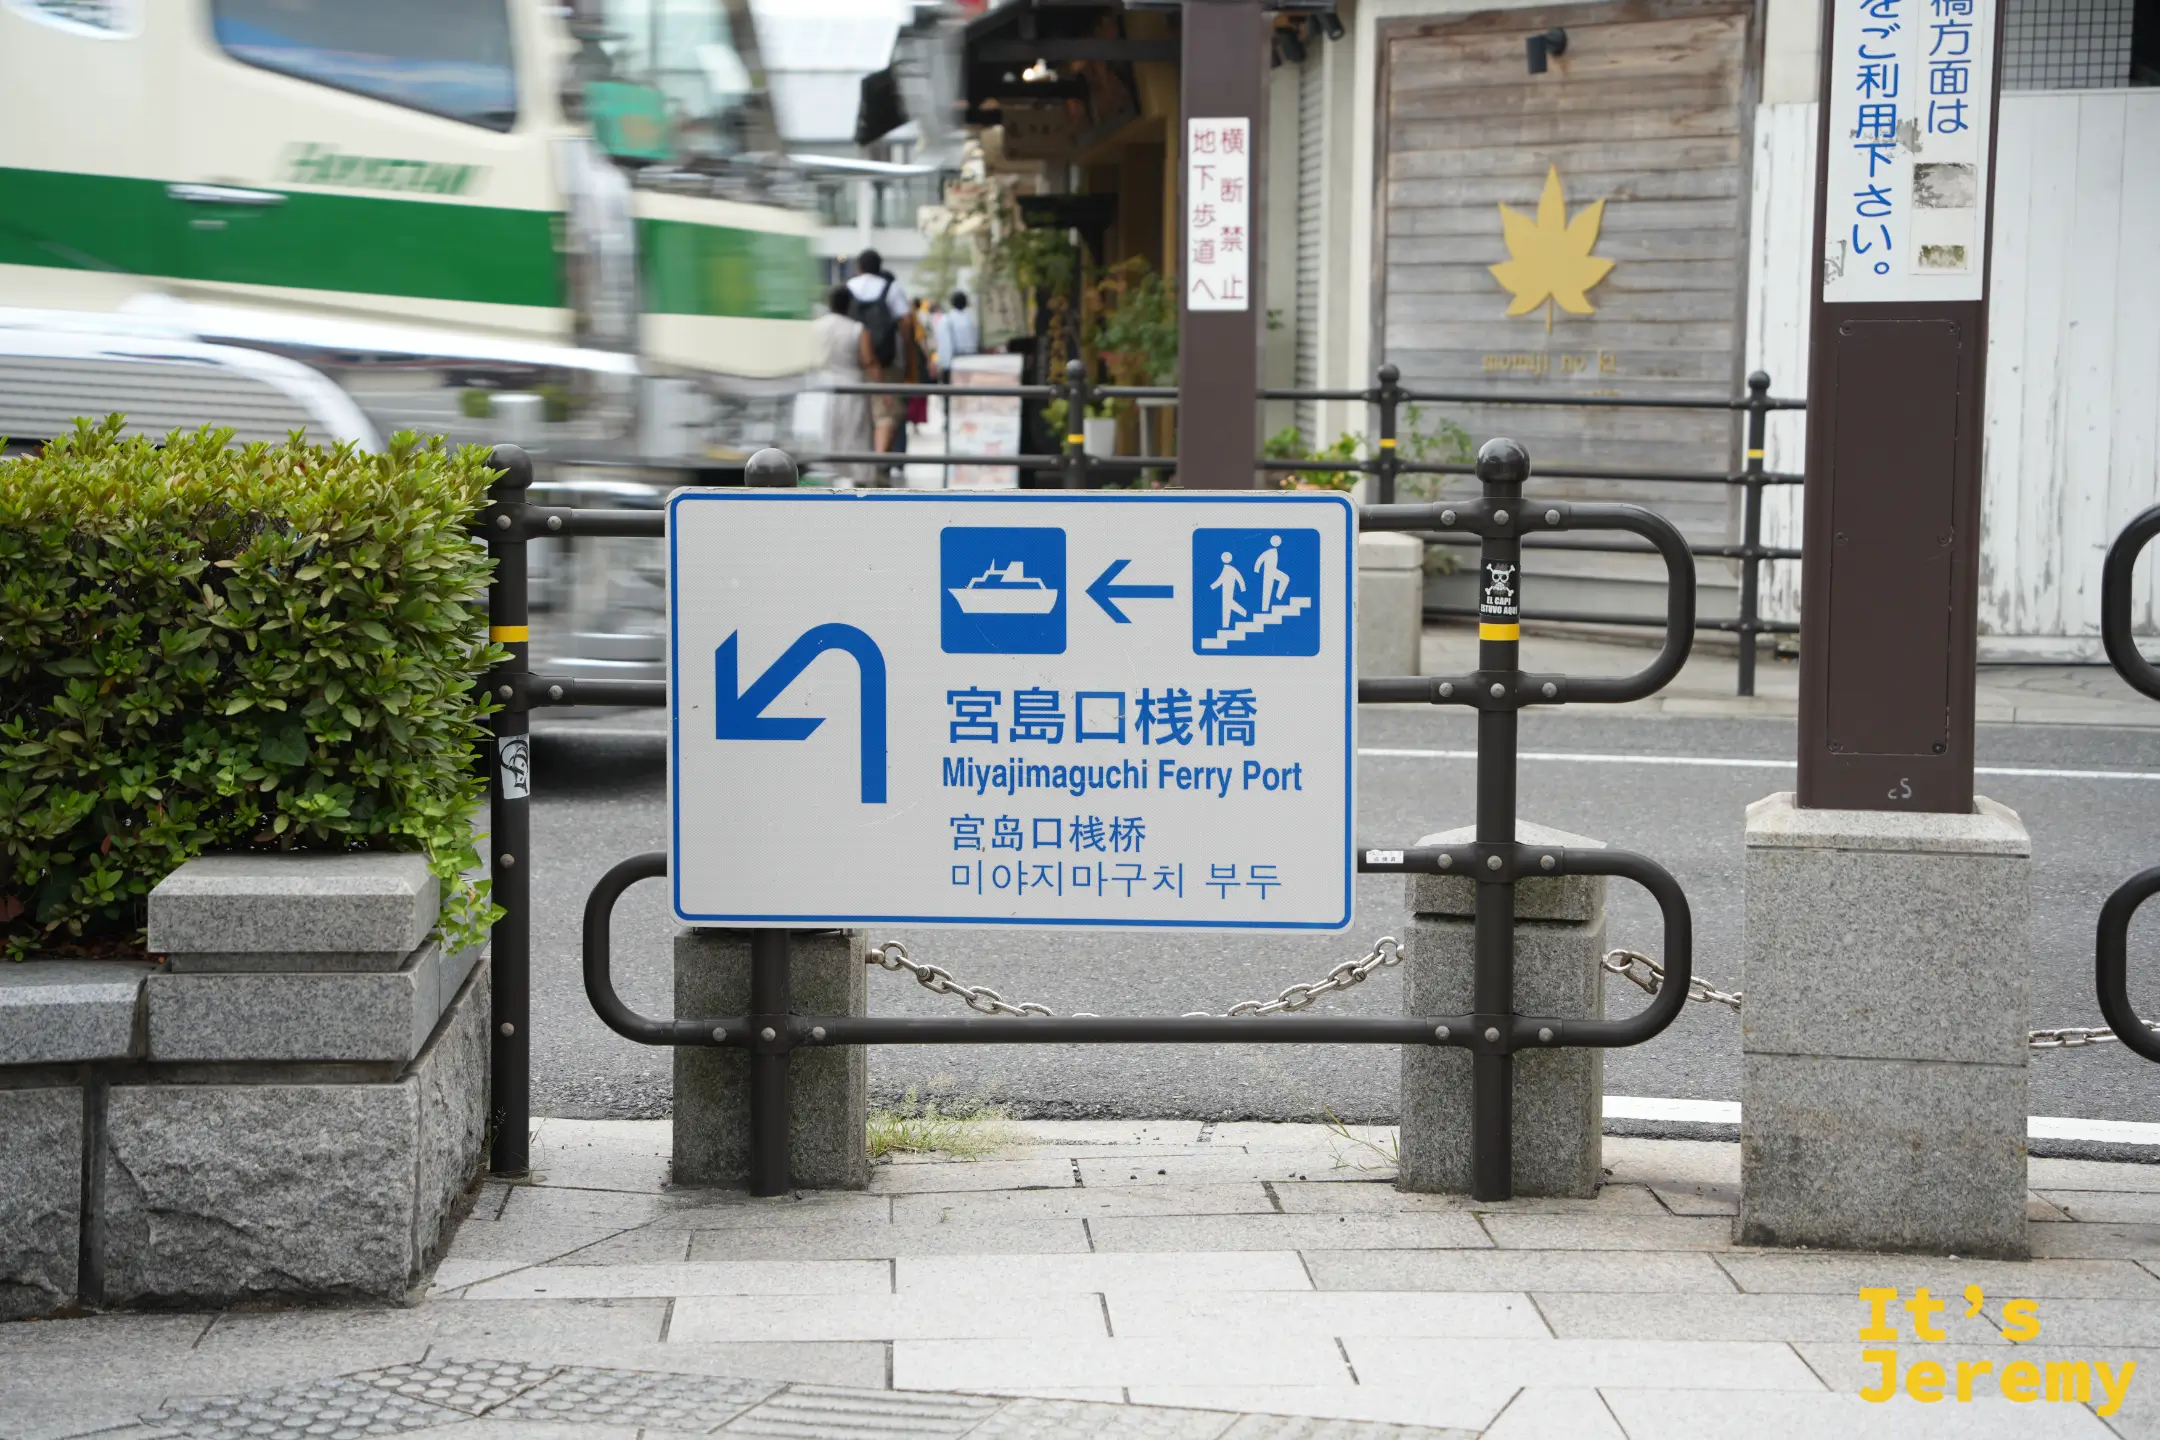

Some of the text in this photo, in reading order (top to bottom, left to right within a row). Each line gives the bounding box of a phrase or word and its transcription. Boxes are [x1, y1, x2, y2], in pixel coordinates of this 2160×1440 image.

[1192, 128, 1217, 300] 地下歩道へ
[1220, 128, 1245, 300] 横断禁止
[1483, 351, 1549, 377] momiji
[1560, 353, 1587, 373] no
[1486, 595, 1512, 606] EL CAPI
[946, 686, 1258, 746] 宮島口桟橋
[942, 757, 1302, 798] Miyajimaguchi Ferry Port
[951, 860, 1283, 900] 미야지마구치 부두
